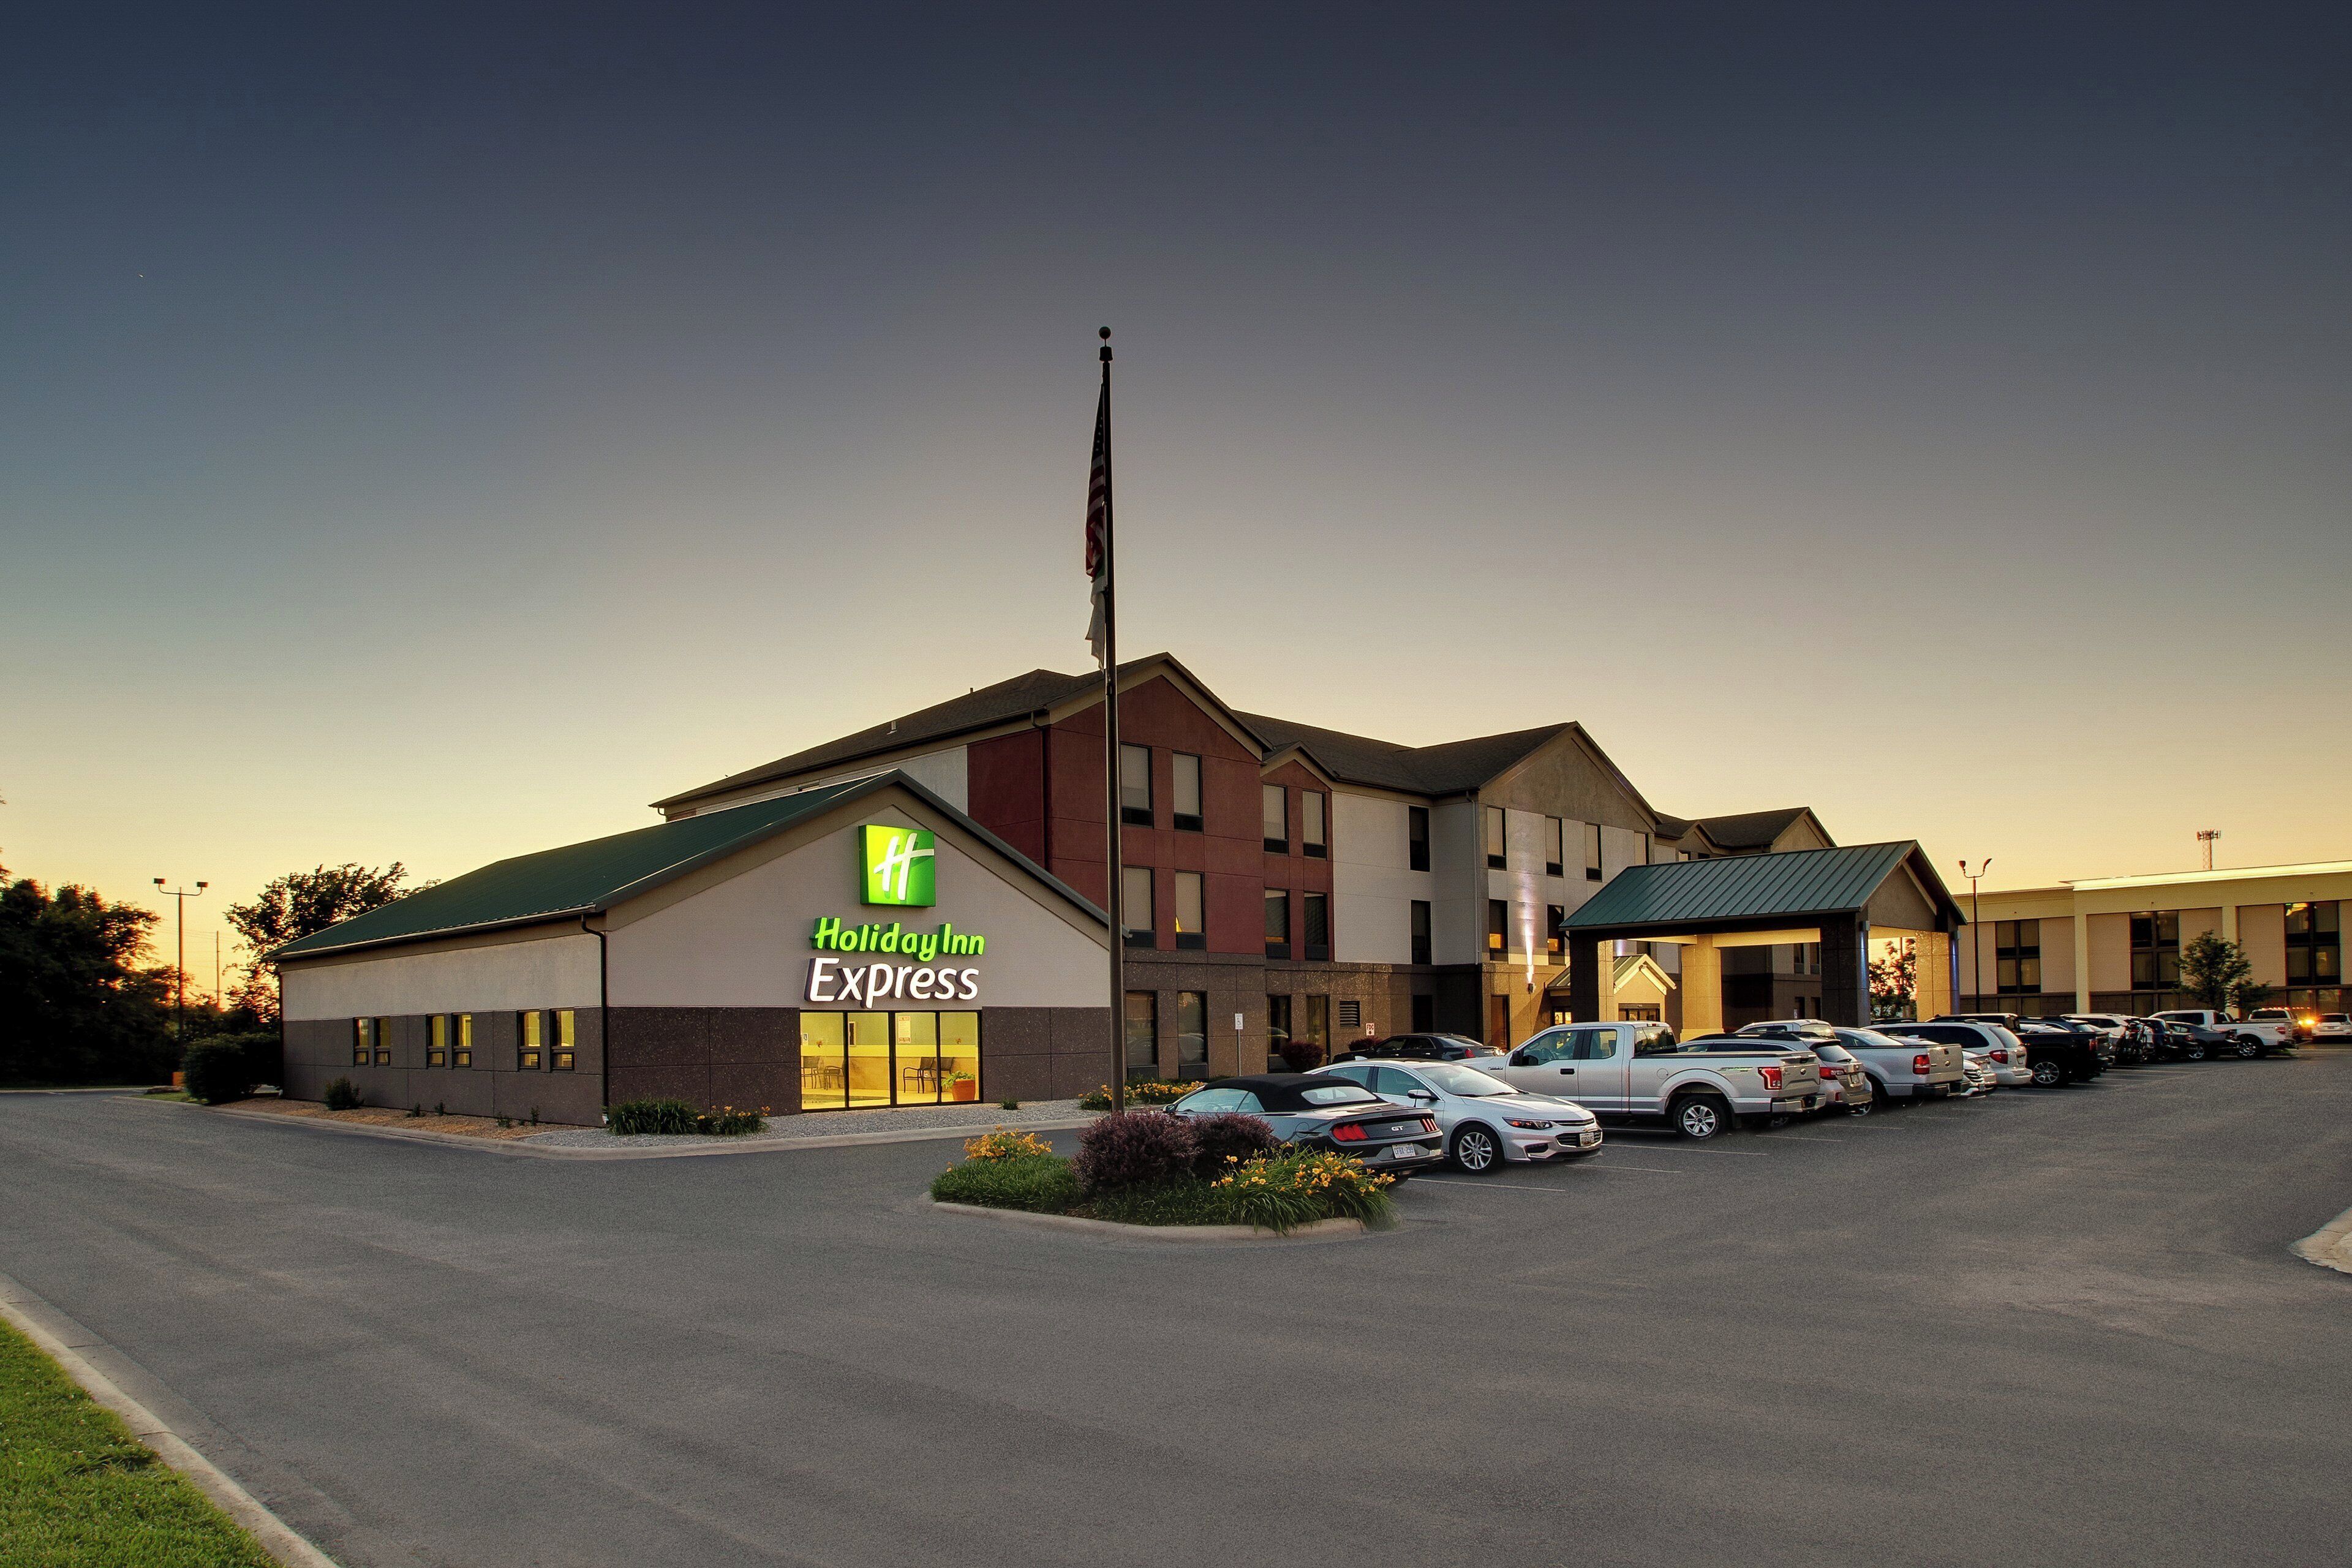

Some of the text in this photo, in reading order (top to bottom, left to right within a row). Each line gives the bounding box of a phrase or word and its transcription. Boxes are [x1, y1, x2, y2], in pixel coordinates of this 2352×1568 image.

[812, 918, 986, 962] Holiday Inn
[807, 957, 979, 1009] Express
